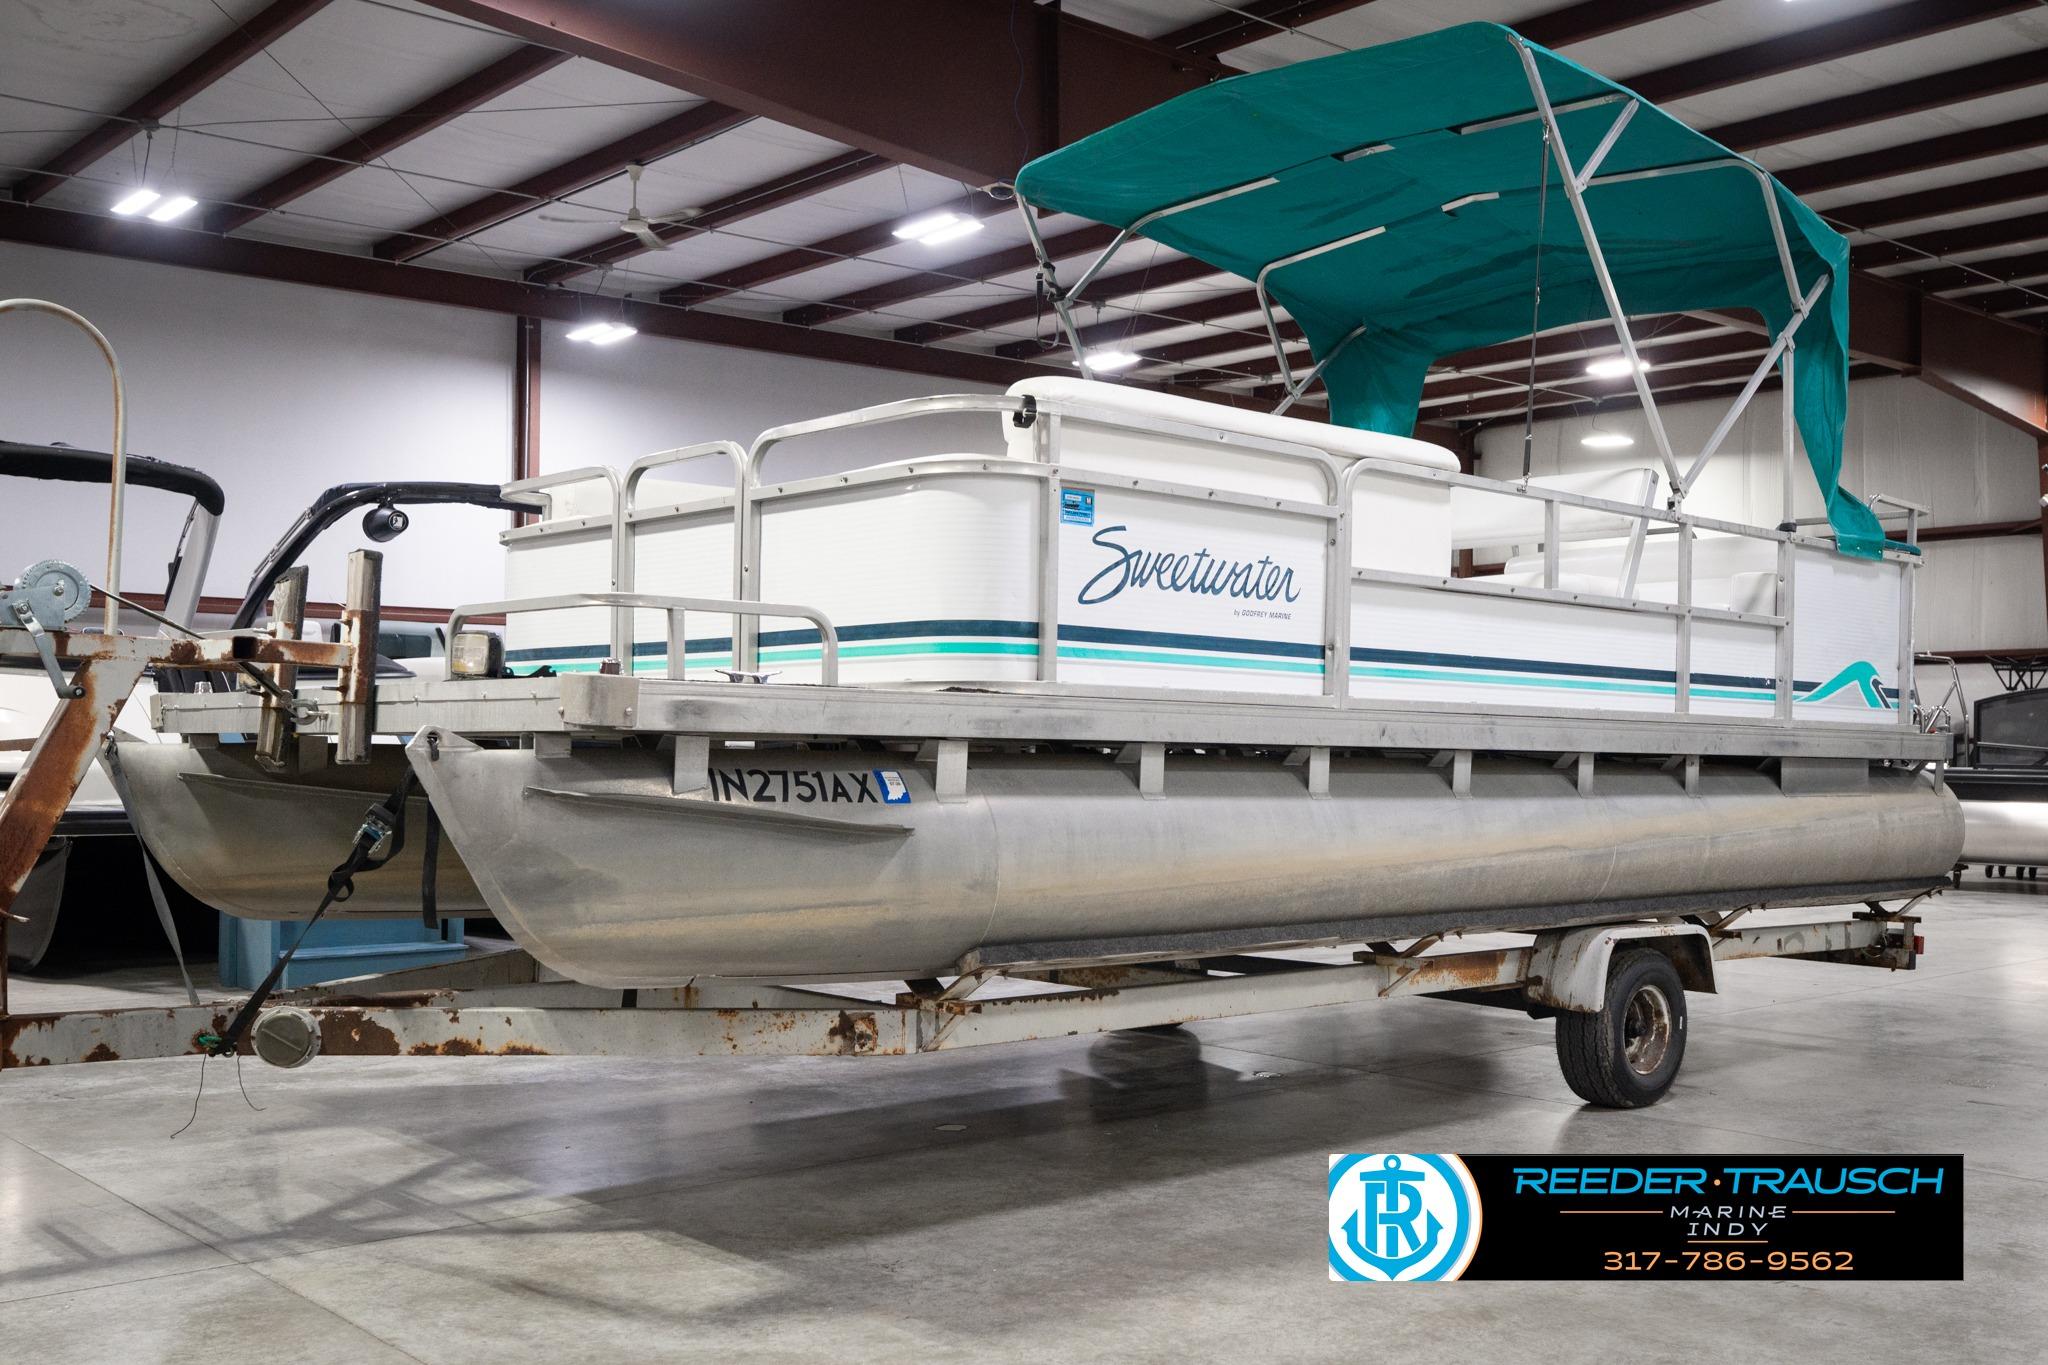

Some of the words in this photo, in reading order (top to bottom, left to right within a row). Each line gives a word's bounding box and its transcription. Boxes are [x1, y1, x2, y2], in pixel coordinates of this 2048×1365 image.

[1077, 525, 1301, 604] Sweetwater
[1241, 609, 1268, 619] GODFREY
[1269, 612, 1292, 620] MARINE
